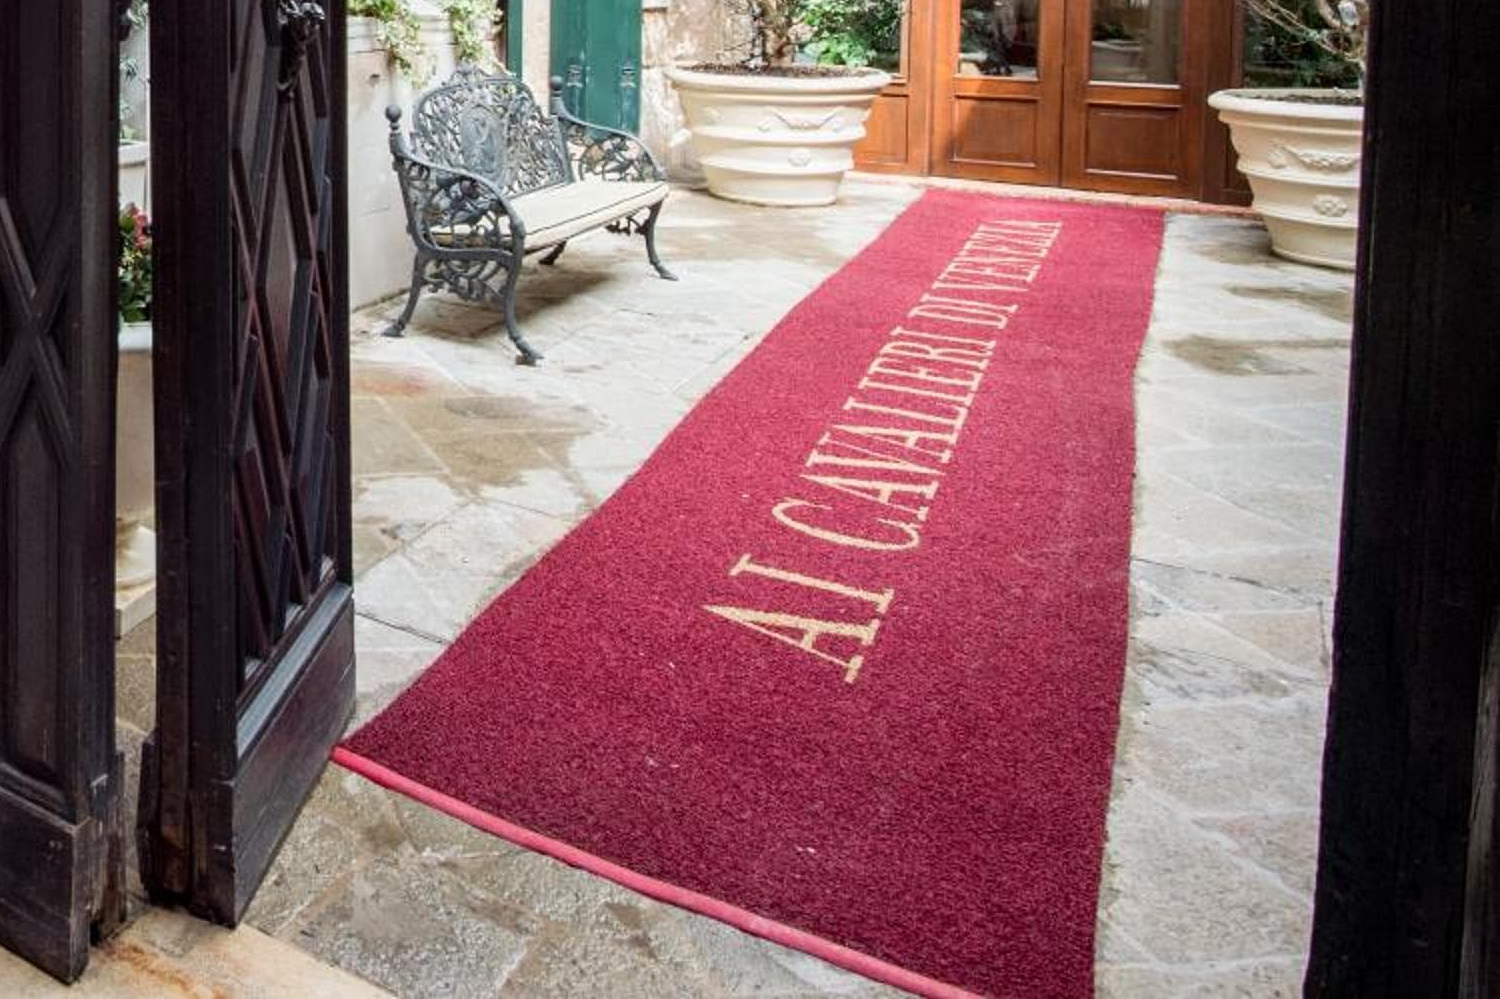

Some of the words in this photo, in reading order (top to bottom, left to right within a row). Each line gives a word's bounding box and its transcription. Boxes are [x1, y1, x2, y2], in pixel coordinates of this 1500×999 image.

[931, 220, 1063, 292] VENEZIA
[907, 292, 1019, 330] DI
[771, 326, 997, 552] CAVALIERI
[702, 553, 895, 684] AI
